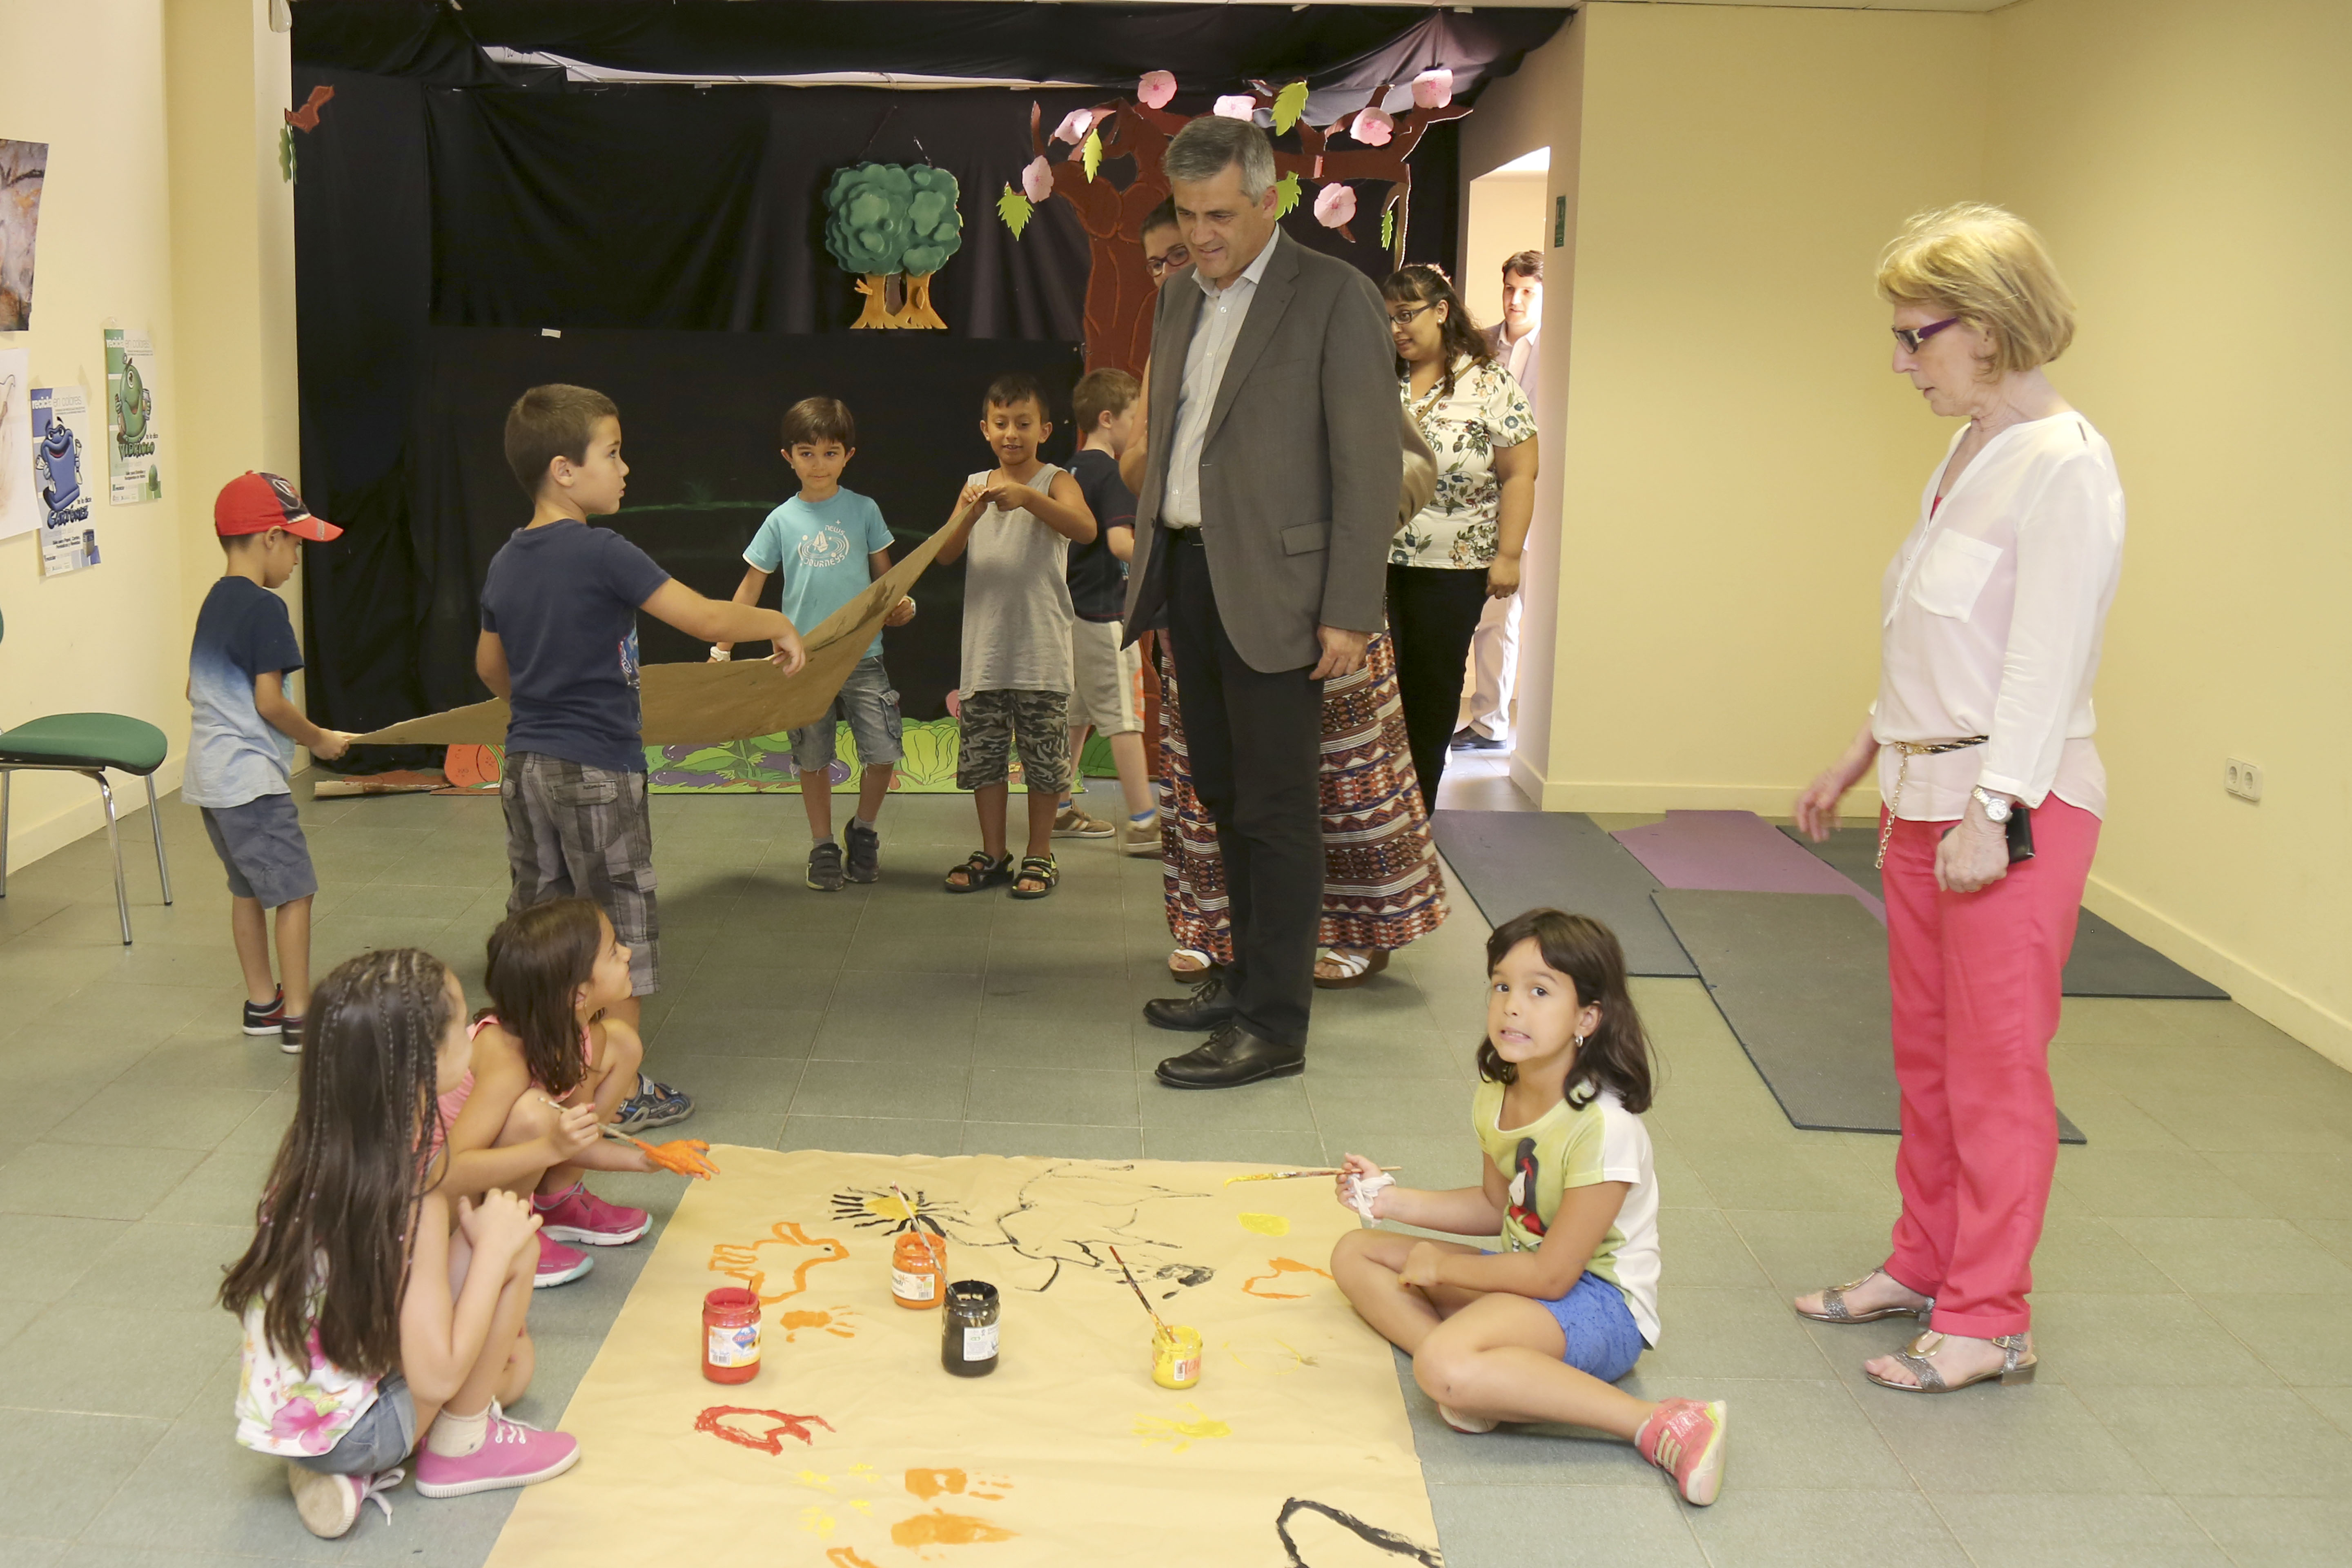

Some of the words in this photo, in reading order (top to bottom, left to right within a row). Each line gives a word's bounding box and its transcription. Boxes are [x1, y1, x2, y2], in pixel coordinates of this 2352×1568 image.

[106, 336, 124, 348] recicla
[125, 339, 131, 348] en
[31, 396, 52, 410] recicla
[53, 398, 61, 407] en
[62, 395, 82, 407] colores
[118, 441, 155, 462] VIDRIOLO
